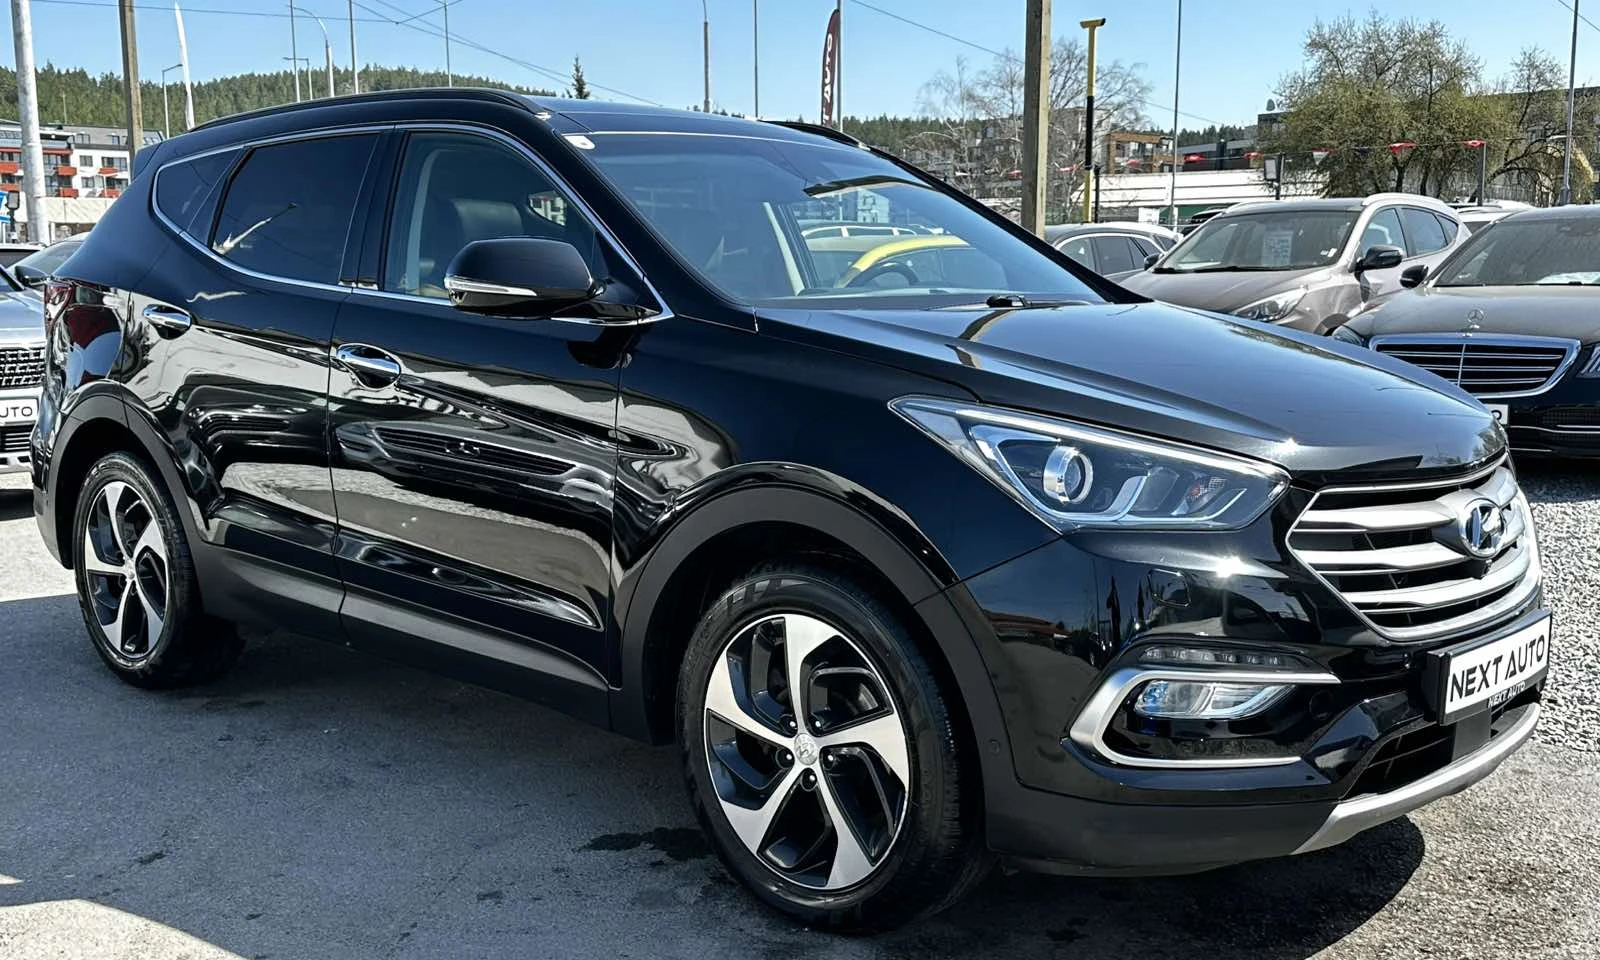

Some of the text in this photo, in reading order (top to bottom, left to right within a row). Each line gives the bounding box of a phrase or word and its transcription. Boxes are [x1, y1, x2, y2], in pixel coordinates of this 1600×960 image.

[823, 33, 833, 103] AUTO
[1450, 634, 1545, 702] NEXT AUTO
